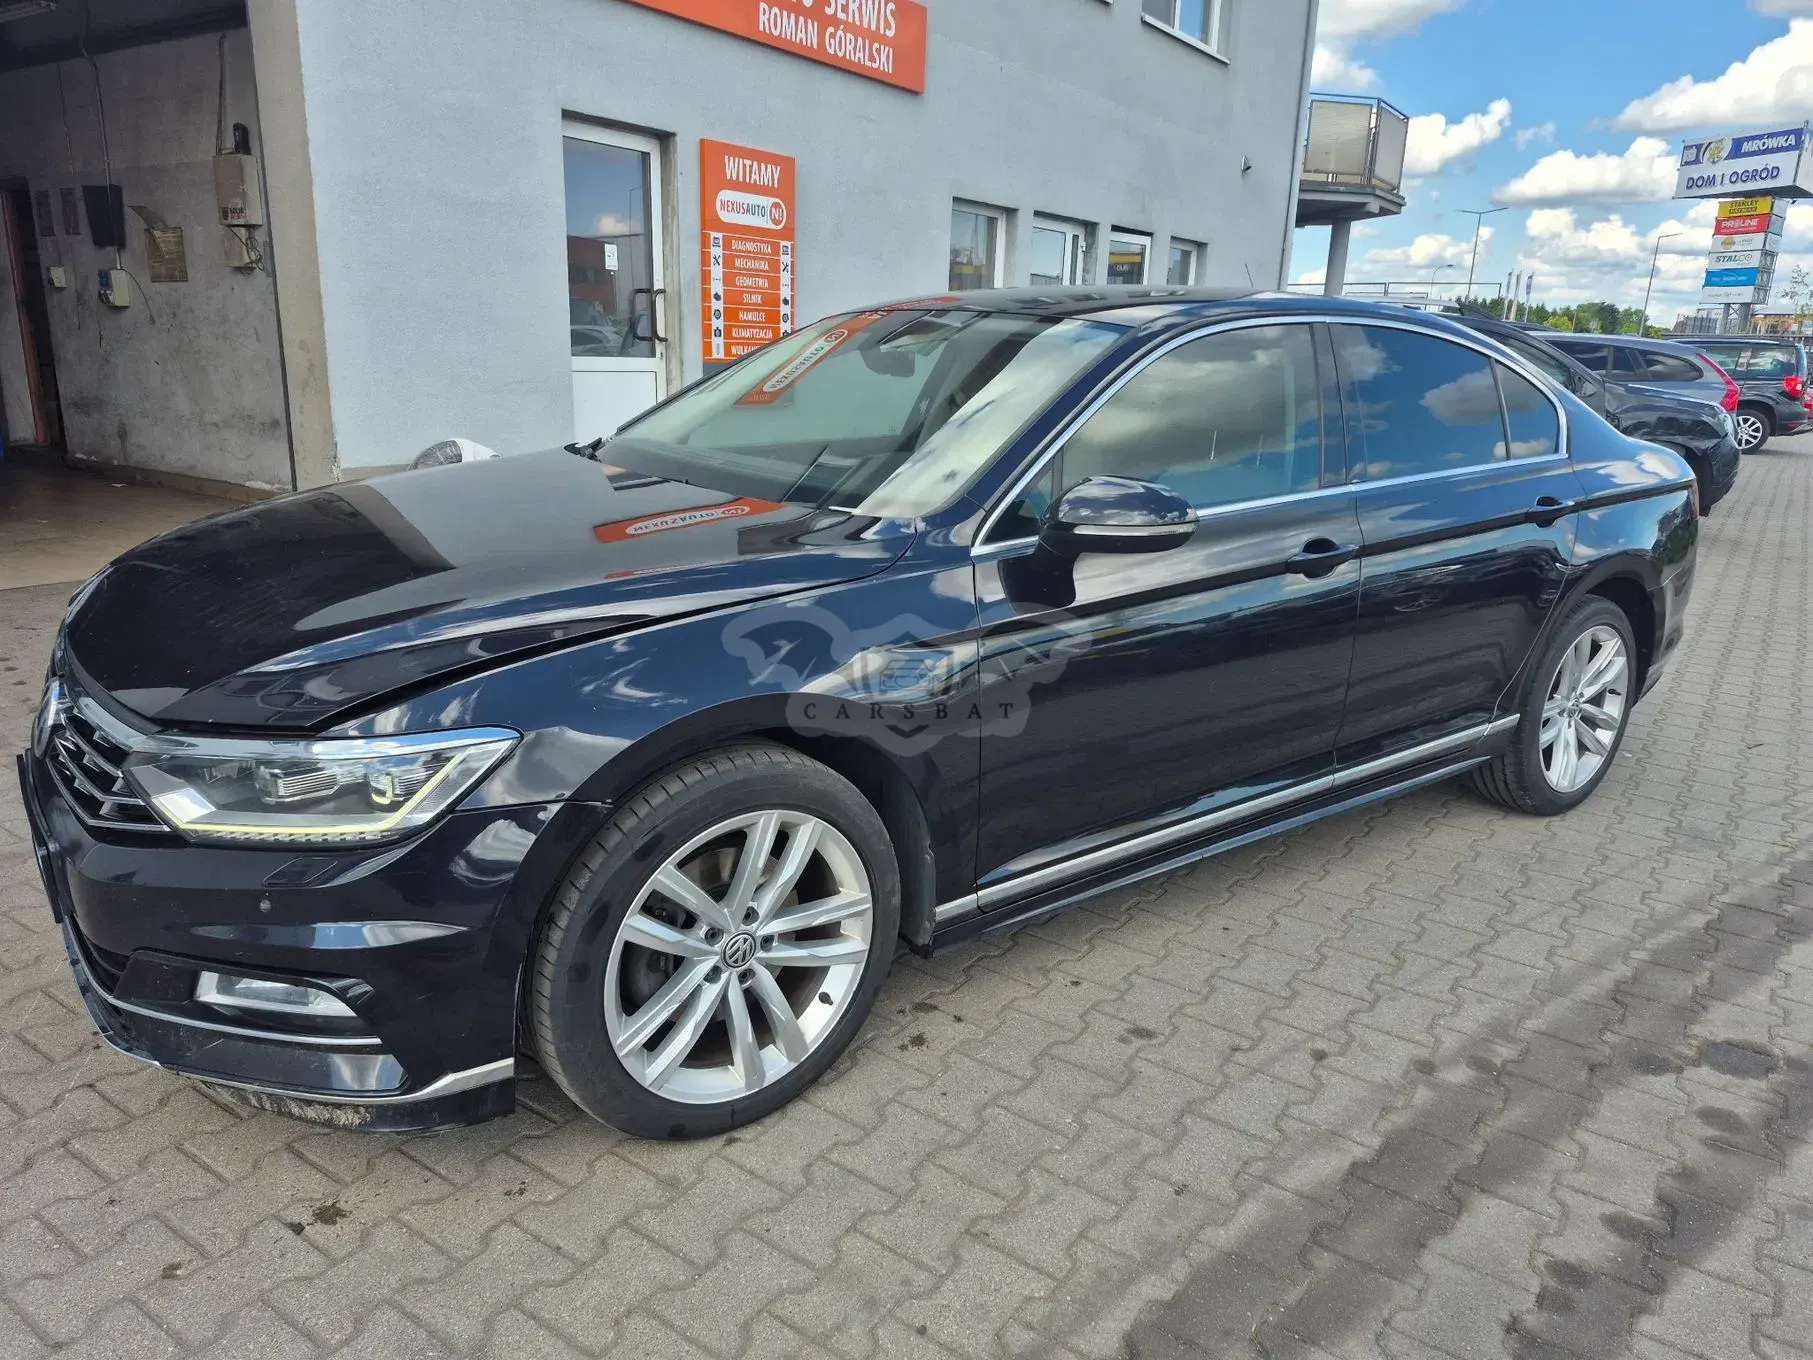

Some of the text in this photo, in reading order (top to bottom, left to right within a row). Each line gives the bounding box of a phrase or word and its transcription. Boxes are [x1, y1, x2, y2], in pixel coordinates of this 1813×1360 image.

[758, 1, 893, 74] ROMAN GÓRALSKI
[1741, 134, 1796, 153] MRÓWKA
[724, 155, 781, 188] WITAMY
[1686, 174, 1716, 190] DOM
[1729, 163, 1780, 184] OGRÓD
[720, 198, 766, 218] NEXUSAUTO
[731, 240, 772, 254] DIAGNOSTYKA
[735, 258, 769, 271] MECHANIKA
[735, 276, 769, 288] GEOMETRIA
[743, 294, 763, 304] SILNIK
[739, 311, 766, 322] HAMULCE
[732, 328, 773, 339] KLIMATYZACJA
